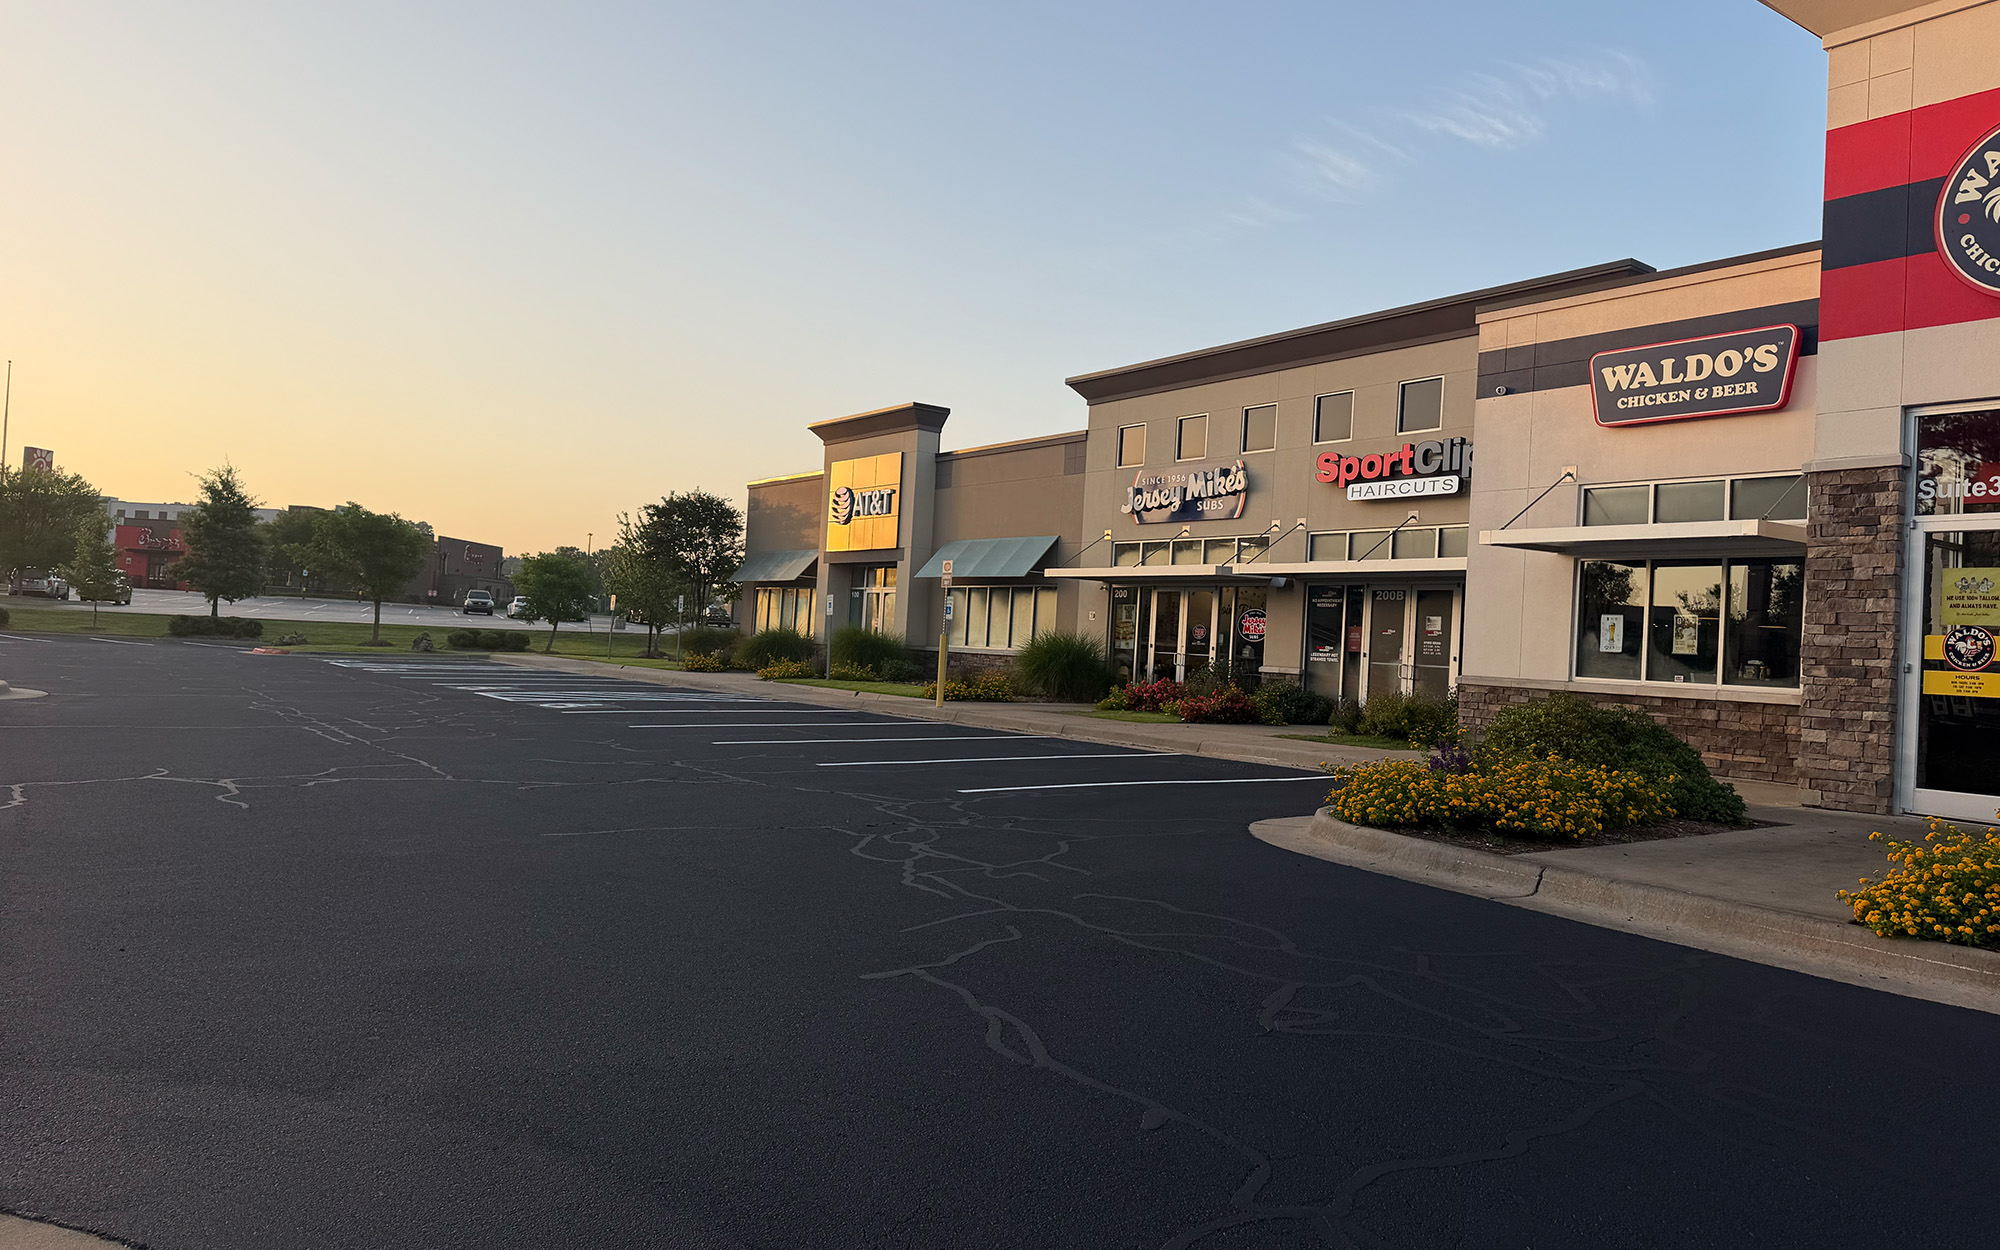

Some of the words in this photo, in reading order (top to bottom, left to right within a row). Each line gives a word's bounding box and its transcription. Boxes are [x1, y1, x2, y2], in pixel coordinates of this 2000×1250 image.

[1960, 233, 2000, 275] CHIC
[1601, 343, 1779, 392] WALDO'S
[1616, 389, 1692, 410] CHICKEN
[1694, 387, 1710, 400] &
[1711, 381, 1759, 399] BEER
[1141, 476, 1166, 486] SINCE
[1167, 474, 1187, 483] 1956
[1350, 478, 1455, 498] HAIRCUTS
[1120, 486, 1182, 515] Jersey
[1185, 465, 1247, 501] Mike's
[852, 488, 893, 517] AT&T
[1196, 499, 1224, 511] SUBS
[1114, 589, 1128, 598] 200
[1375, 590, 1405, 601] 200B
[1242, 614, 1266, 626] Jersey
[1947, 628, 1991, 646] WALDO'S
